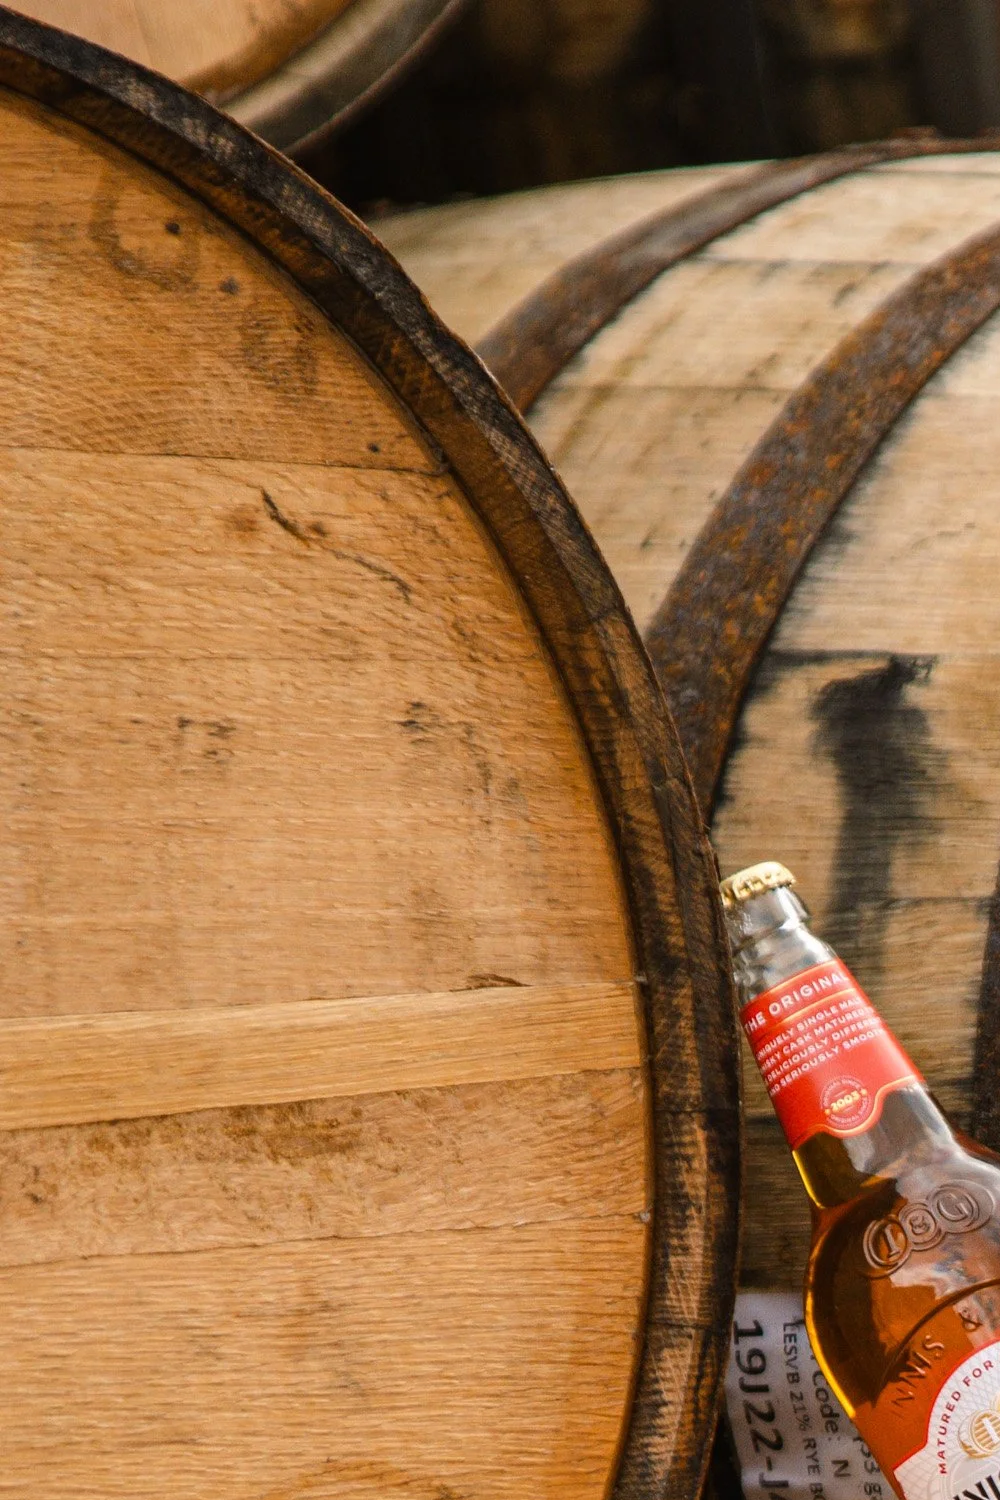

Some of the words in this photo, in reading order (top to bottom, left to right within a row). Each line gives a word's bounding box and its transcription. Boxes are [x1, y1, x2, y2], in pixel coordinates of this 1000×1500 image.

[745, 1011, 766, 1033] THE
[769, 972, 849, 1017] ORIGINAL
[797, 1005, 839, 1031] SINGLE
[782, 1032, 812, 1055] CASK
[780, 1045, 840, 1087] SERIOUSLY
[831, 1089, 860, 1112] 2003
[789, 1390, 814, 1432] 21%
[803, 1437, 820, 1475] RYE
[937, 1390, 962, 1475] MATURED
[962, 1359, 995, 1387] FOR
[831, 1458, 851, 1479] N
